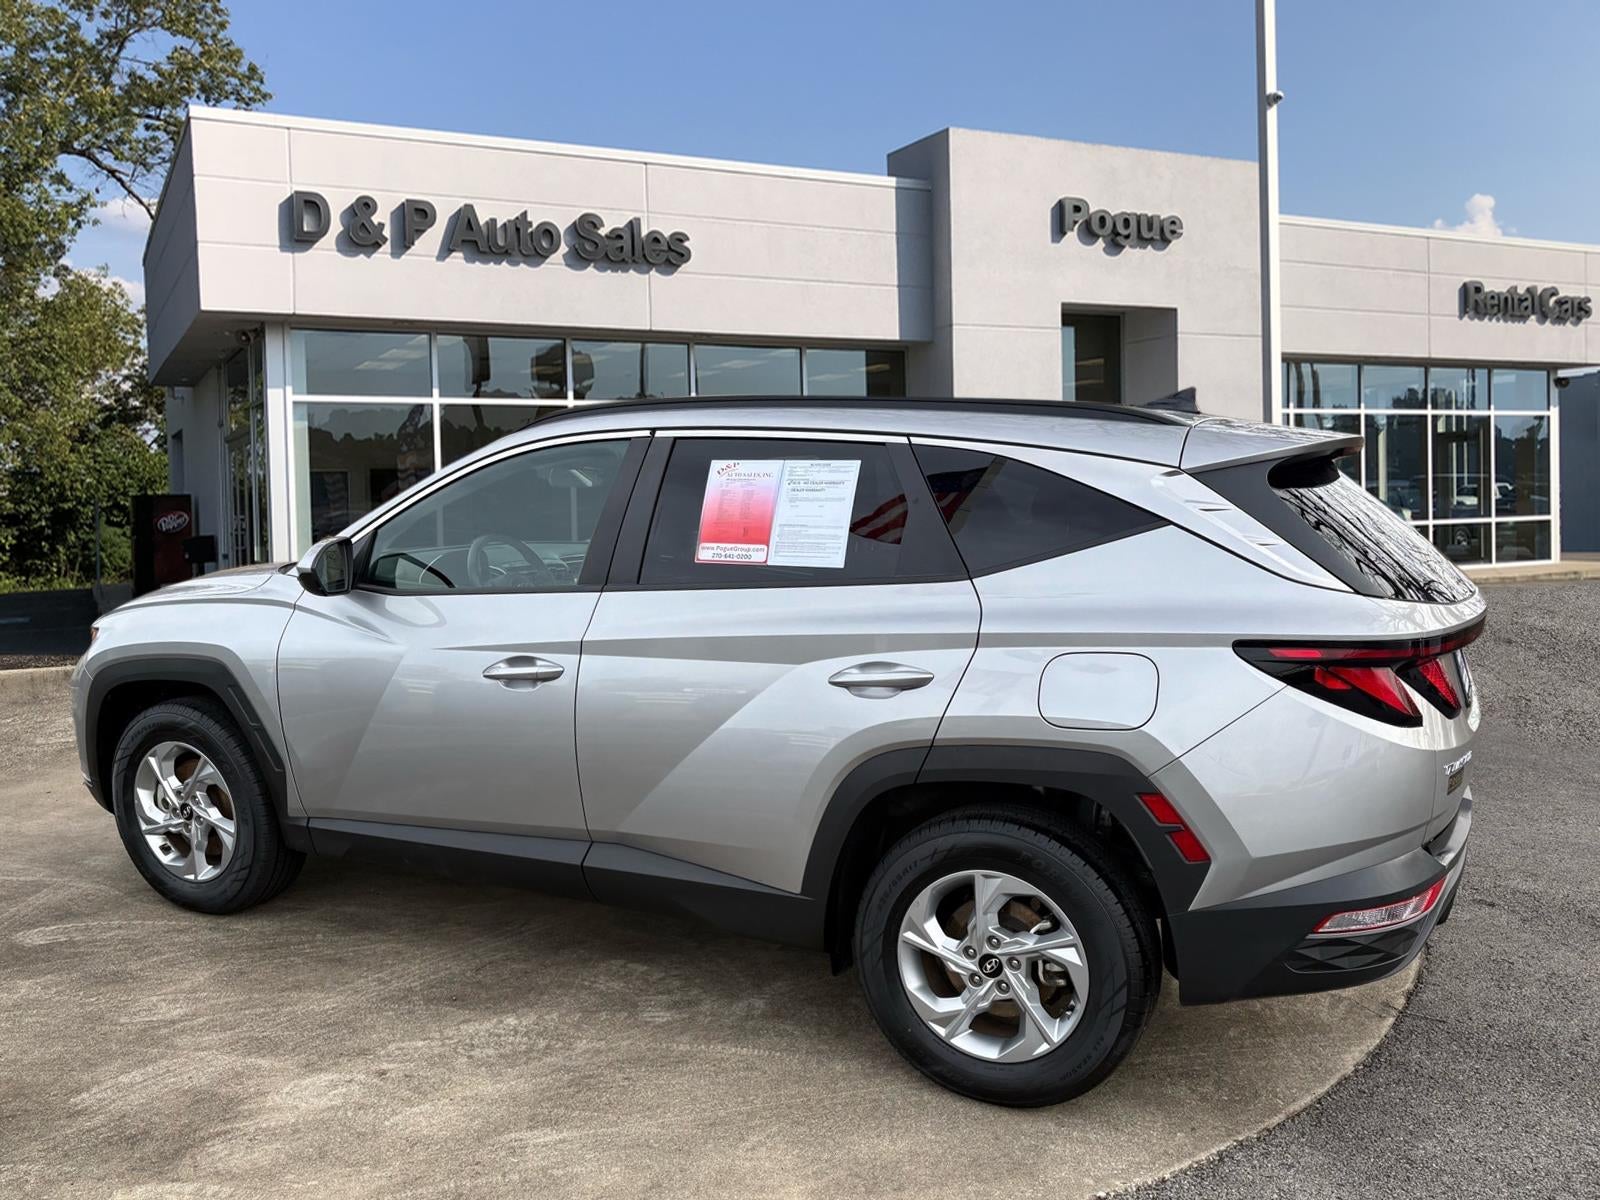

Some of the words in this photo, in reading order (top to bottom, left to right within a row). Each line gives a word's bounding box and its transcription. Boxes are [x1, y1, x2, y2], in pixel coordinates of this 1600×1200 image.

[290, 190, 332, 248] D
[341, 195, 388, 252] &
[400, 198, 438, 252] P
[446, 203, 562, 261] Auto
[570, 211, 692, 272] Sales
[1057, 196, 1184, 251] Pogue
[1460, 280, 1539, 322] Rental
[1539, 286, 1592, 324] Cars
[700, 545, 765, 553] www.PogueGroup.com
